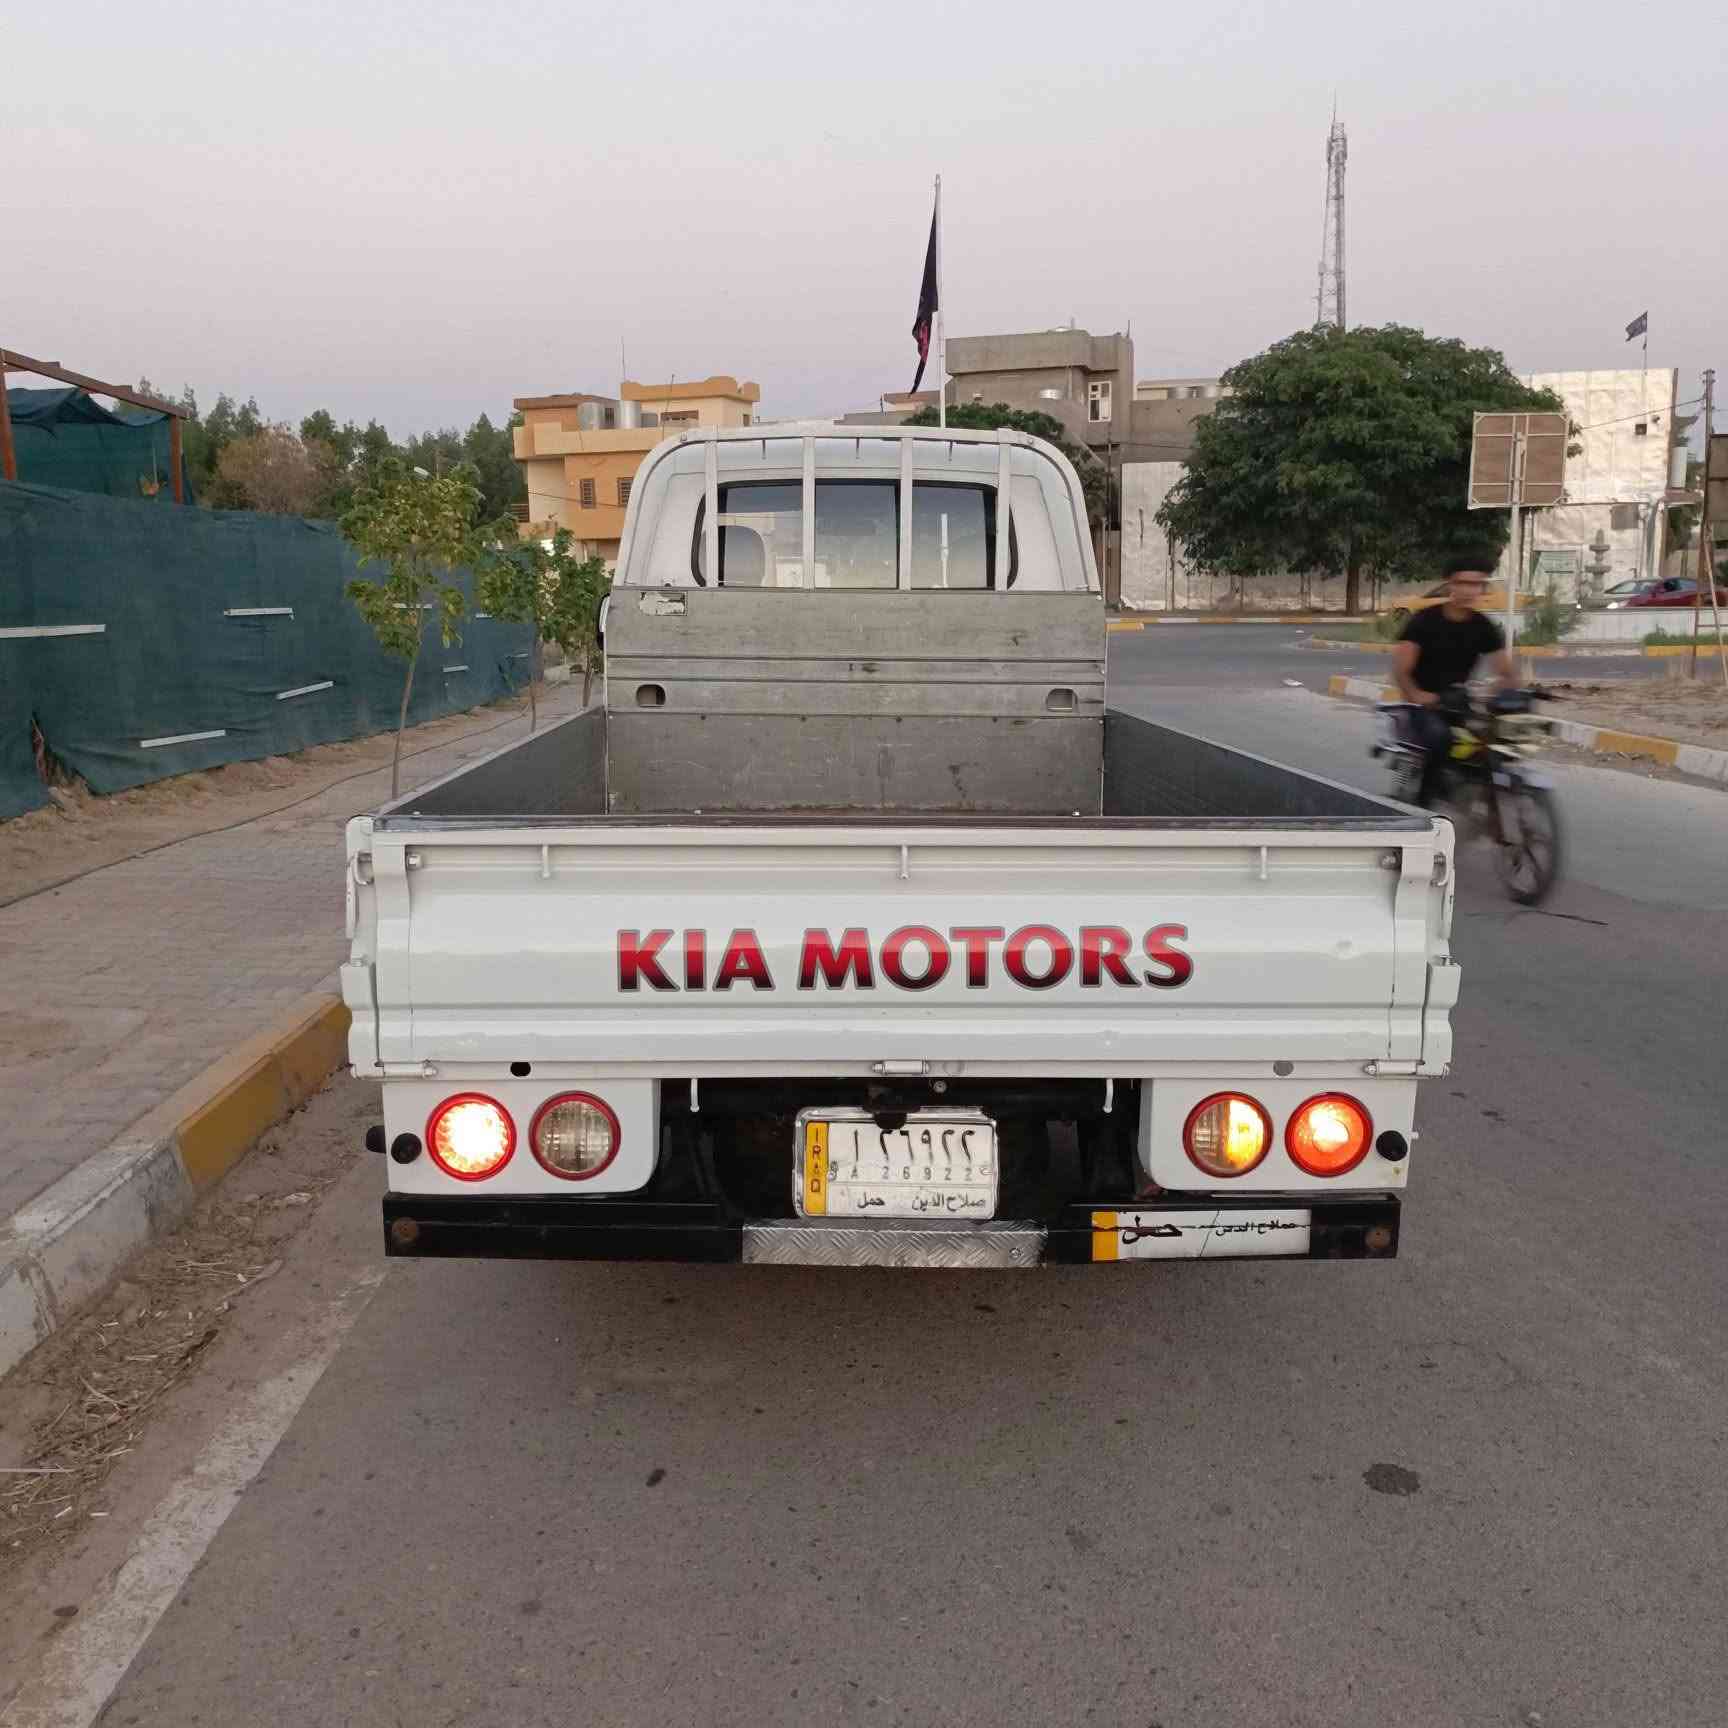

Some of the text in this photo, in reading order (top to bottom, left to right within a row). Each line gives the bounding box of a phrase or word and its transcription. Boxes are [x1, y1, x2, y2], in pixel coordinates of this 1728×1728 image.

[617, 924, 1194, 992] KIA MOTORS
[854, 1129, 975, 1164] ١٢٦٩٢٢
[857, 1192, 885, 1209] حمل
[946, 1192, 986, 1211] صلاح
